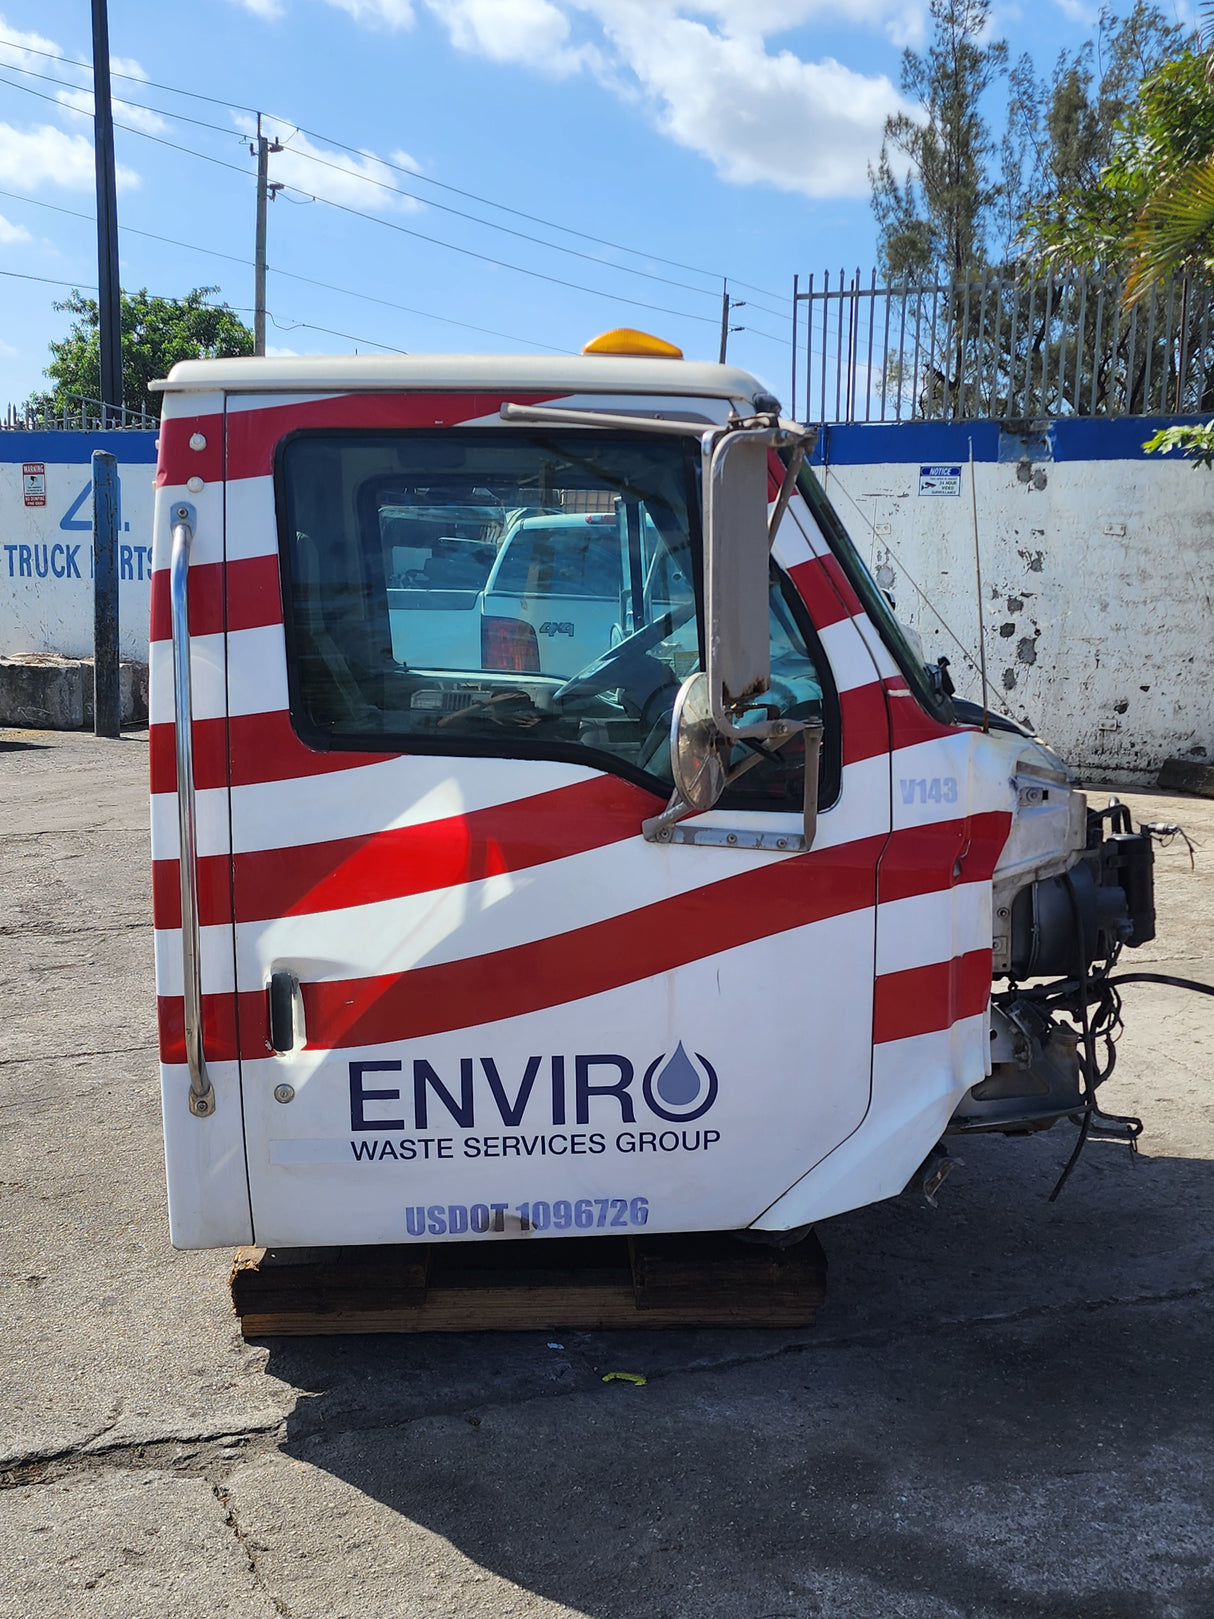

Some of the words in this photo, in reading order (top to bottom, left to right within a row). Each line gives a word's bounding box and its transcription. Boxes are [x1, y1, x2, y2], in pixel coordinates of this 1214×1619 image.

[930, 467, 952, 475] NOTICE
[4, 543, 81, 579] TRUCK
[90, 544, 153, 581] RTS
[900, 777, 958, 805] V143
[348, 1040, 718, 1132] ENVIRO
[350, 1138, 454, 1161] WASTE
[463, 1133, 606, 1158] SERVICES
[615, 1129, 721, 1153] GROUP
[405, 1203, 509, 1236] USDOT
[515, 1197, 650, 1231] 1096726
